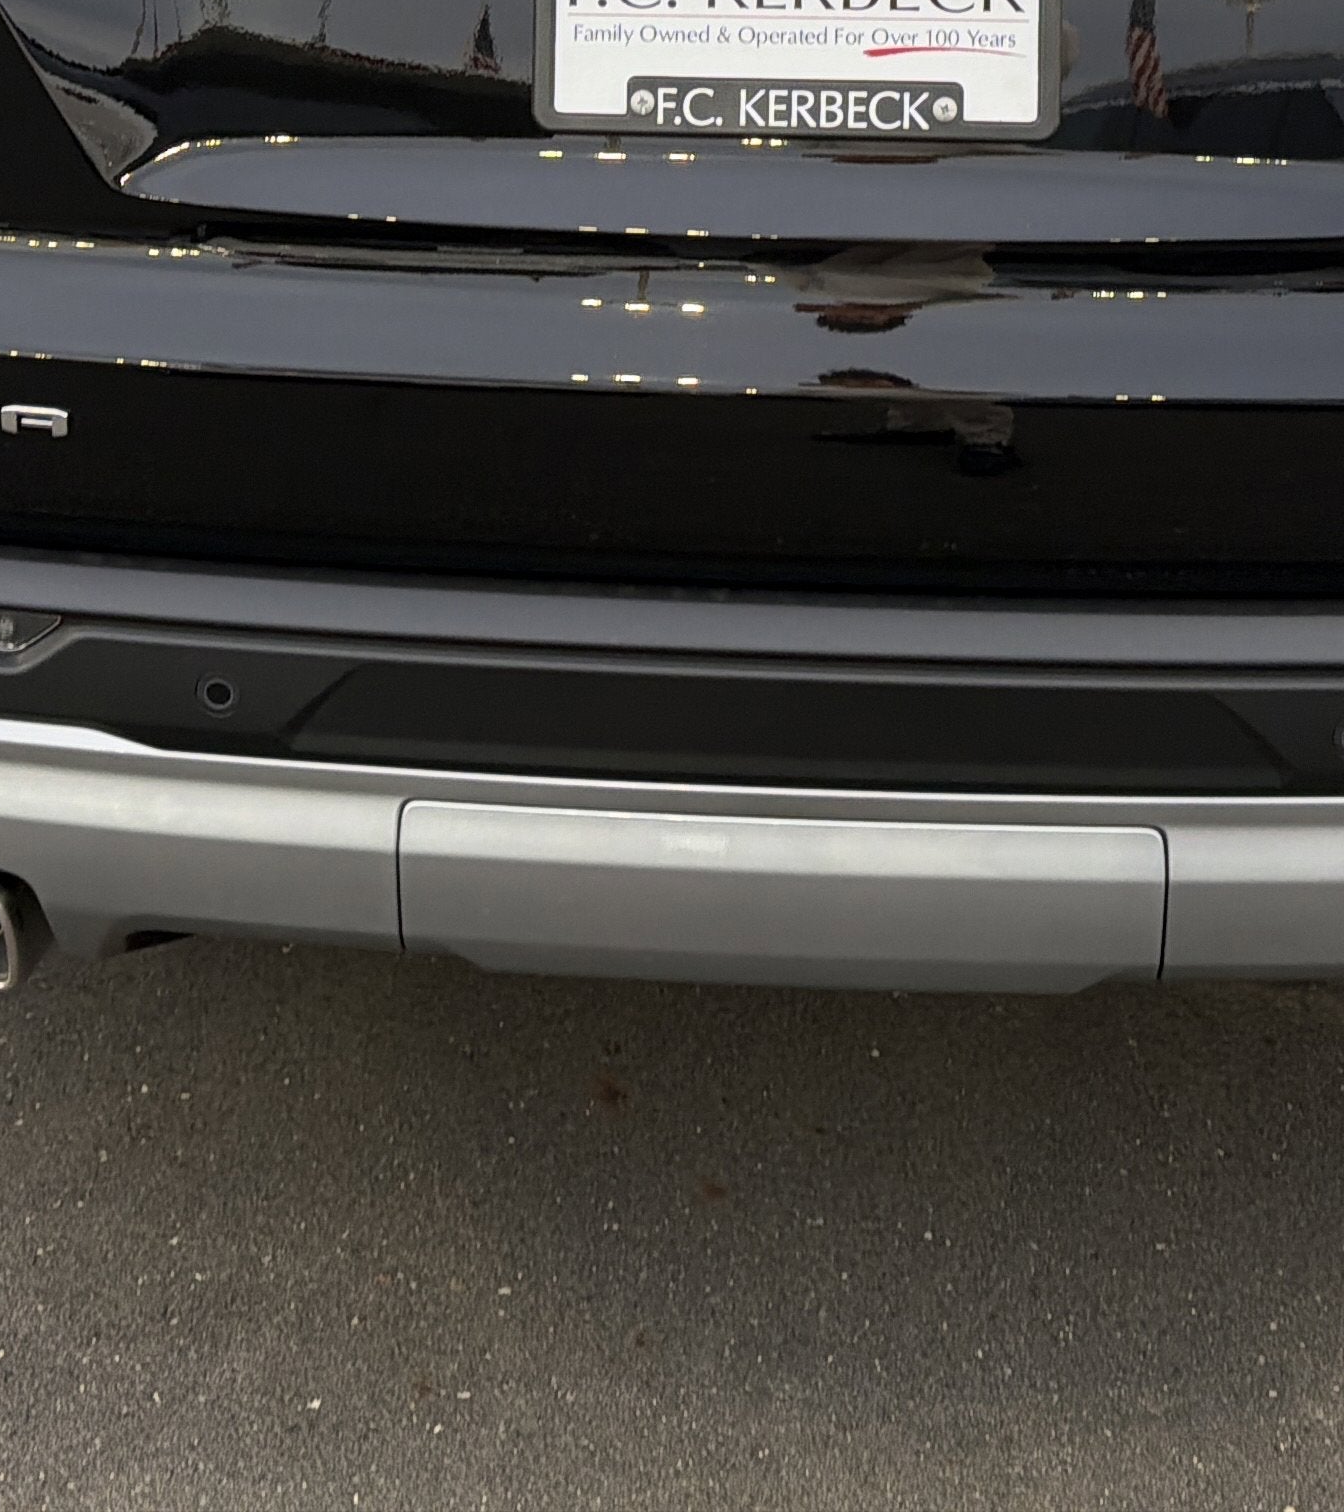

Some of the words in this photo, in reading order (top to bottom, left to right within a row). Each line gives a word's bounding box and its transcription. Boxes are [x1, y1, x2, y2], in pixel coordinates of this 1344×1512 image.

[573, 23, 634, 48] Family
[639, 24, 711, 45] Owned
[716, 26, 732, 45] &
[738, 26, 829, 49] Operated
[834, 27, 864, 46] For
[871, 28, 919, 47] Over
[925, 29, 959, 47] 100
[968, 30, 1017, 48] Years
[656, 87, 723, 128] F.C.
[739, 89, 930, 131] KERBECK
